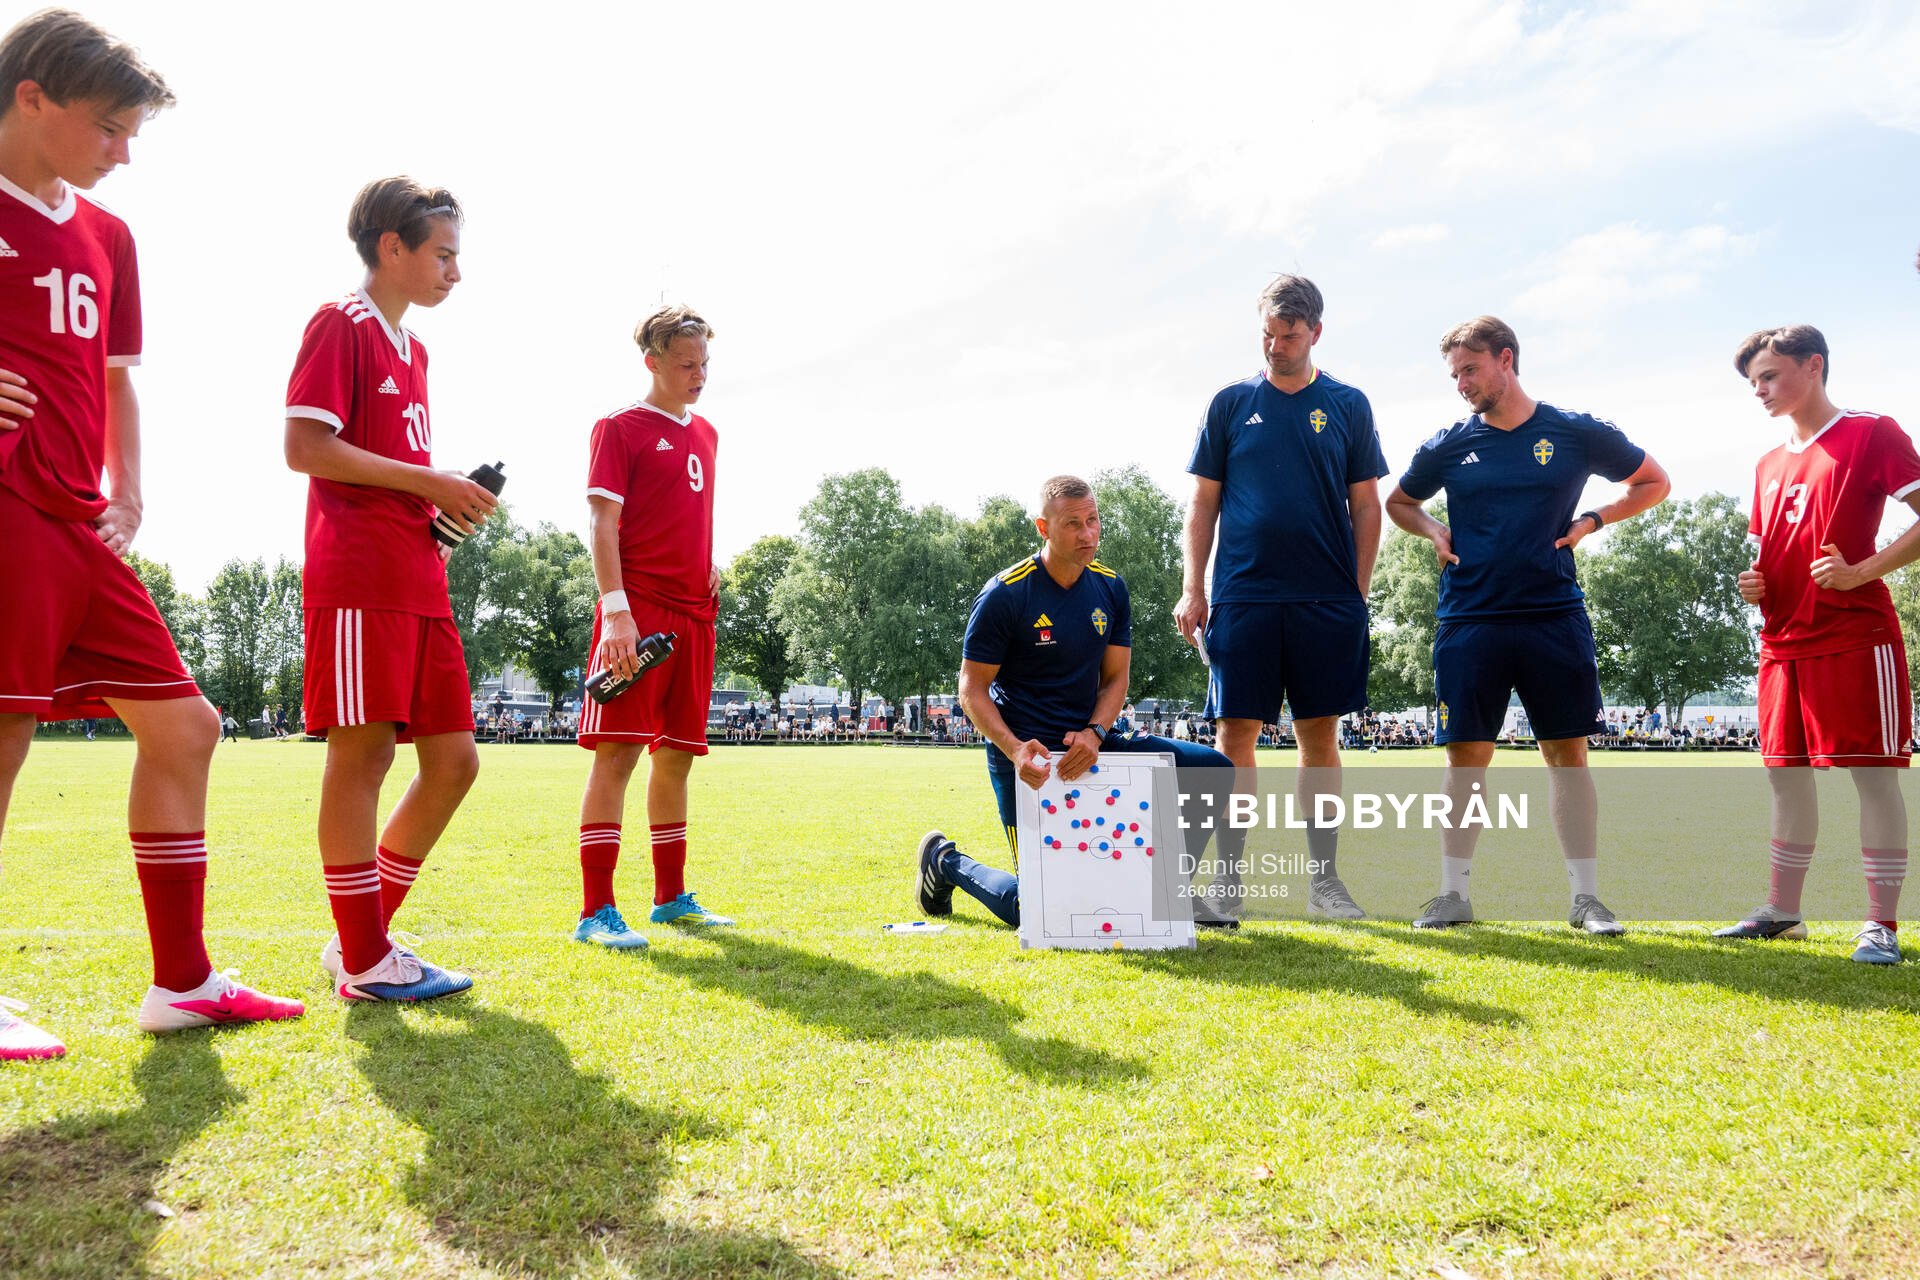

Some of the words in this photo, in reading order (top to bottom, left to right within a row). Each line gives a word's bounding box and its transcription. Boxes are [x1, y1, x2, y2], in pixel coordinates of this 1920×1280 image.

[33, 267, 99, 339] 16
[402, 402, 431, 453] 10
[687, 453, 704, 492] 9
[1785, 483, 1807, 524] 3
